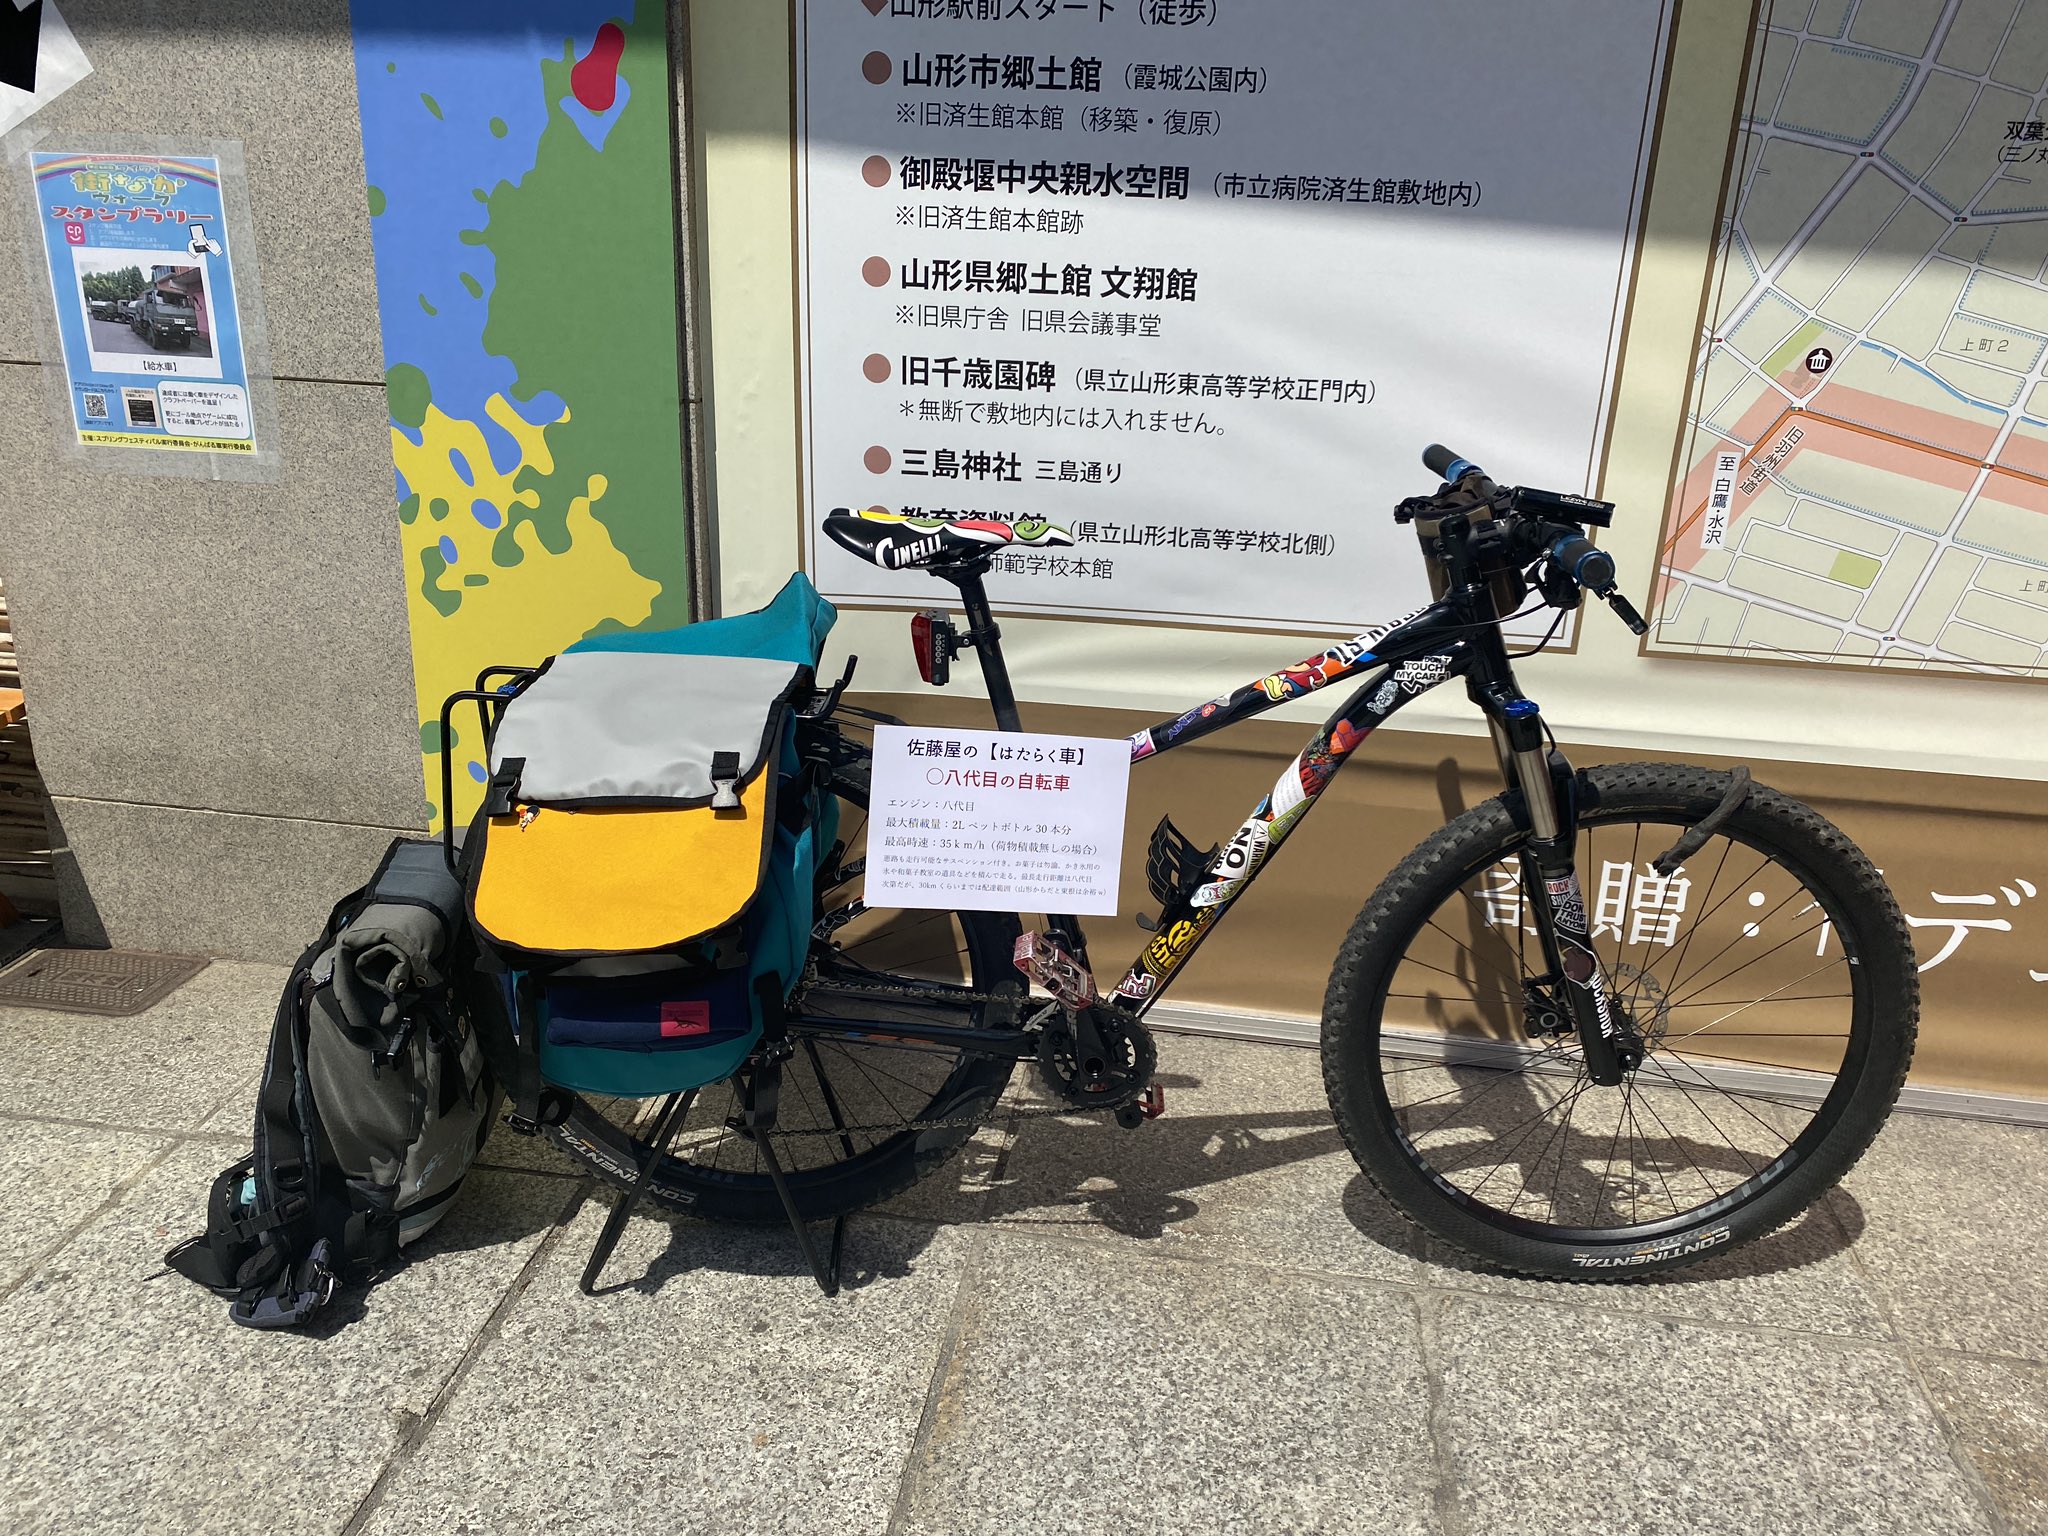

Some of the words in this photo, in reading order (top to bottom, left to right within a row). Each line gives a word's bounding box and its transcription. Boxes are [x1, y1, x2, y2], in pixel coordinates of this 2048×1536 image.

[901, 51, 1102, 93] 山形市郷土館
[1122, 63, 1269, 95] （霞城公園内）
[2003, 121, 2048, 141] 双葉
[71, 171, 187, 195] 街なか
[899, 155, 1190, 200] 御殿堰中央親水空間
[1211, 174, 1485, 208] （市立病院済生館敷地内）
[92, 193, 171, 206] ウォーク
[51, 206, 213, 224] スタンプラリー
[900, 257, 1092, 298] 山形県郷土館
[1100, 265, 1198, 302] 文翔館
[1021, 309, 1162, 339] 旧県会議事堂
[900, 354, 1057, 393] 旧千歳園碑
[1073, 366, 1379, 405] （県立山形東高等学校正門内）
[900, 447, 1023, 484] 三島神社
[1035, 458, 1124, 485] 三島通り
[1718, 456, 1737, 471] 至
[1739, 425, 1804, 496] 旧羽州街道
[1396, 671, 1412, 679] MY
[1405, 662, 1443, 671] TOUCH
[1548, 880, 1569, 893] ROCK
[1551, 892, 1571, 906] SHO
[1592, 976, 1614, 1039] OCKSHOX
[558, 1124, 695, 1204] CONINENTAL
[1571, 1230, 1731, 1268] CONTINENTAL
